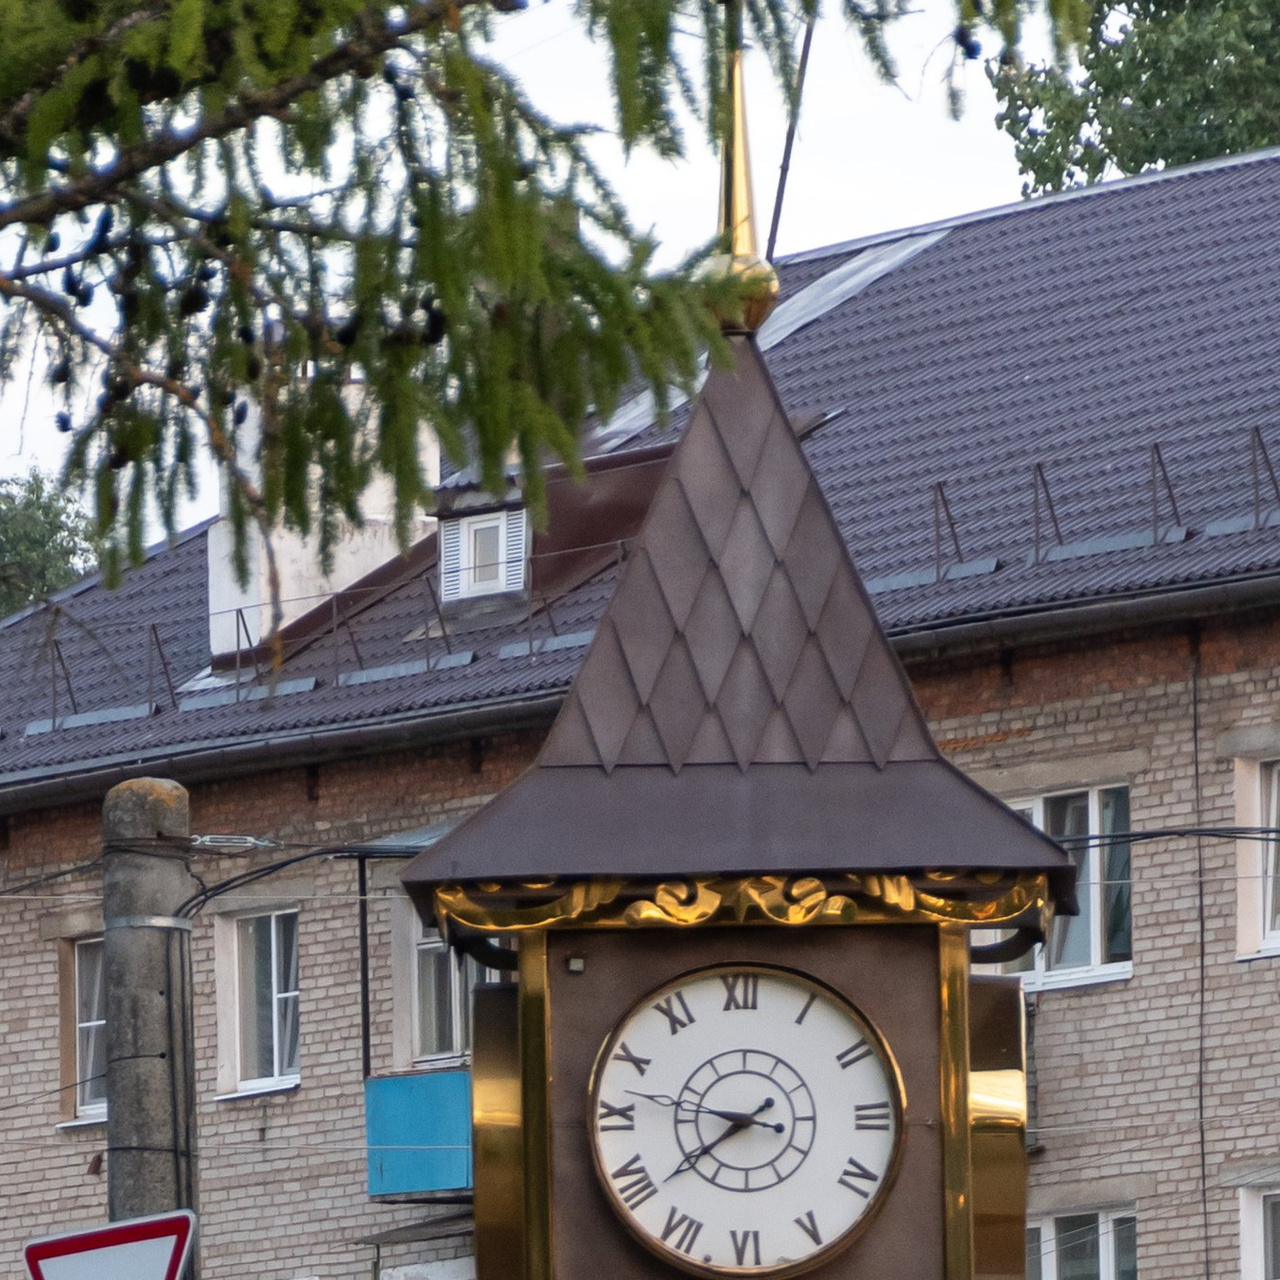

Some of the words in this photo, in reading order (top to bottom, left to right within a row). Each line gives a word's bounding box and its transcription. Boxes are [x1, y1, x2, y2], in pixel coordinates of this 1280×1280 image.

[720, 974, 759, 1011] XII
[653, 990, 697, 1036] XI
[613, 1042, 652, 1077] X
[836, 1037, 873, 1070] II
[599, 1100, 635, 1132] IX
[854, 1101, 890, 1131] III
[612, 1154, 659, 1210] VIII
[837, 1157, 879, 1199] IV
[660, 1206, 704, 1254] VII
[794, 1210, 823, 1246] V
[730, 1230, 761, 1266] VI
